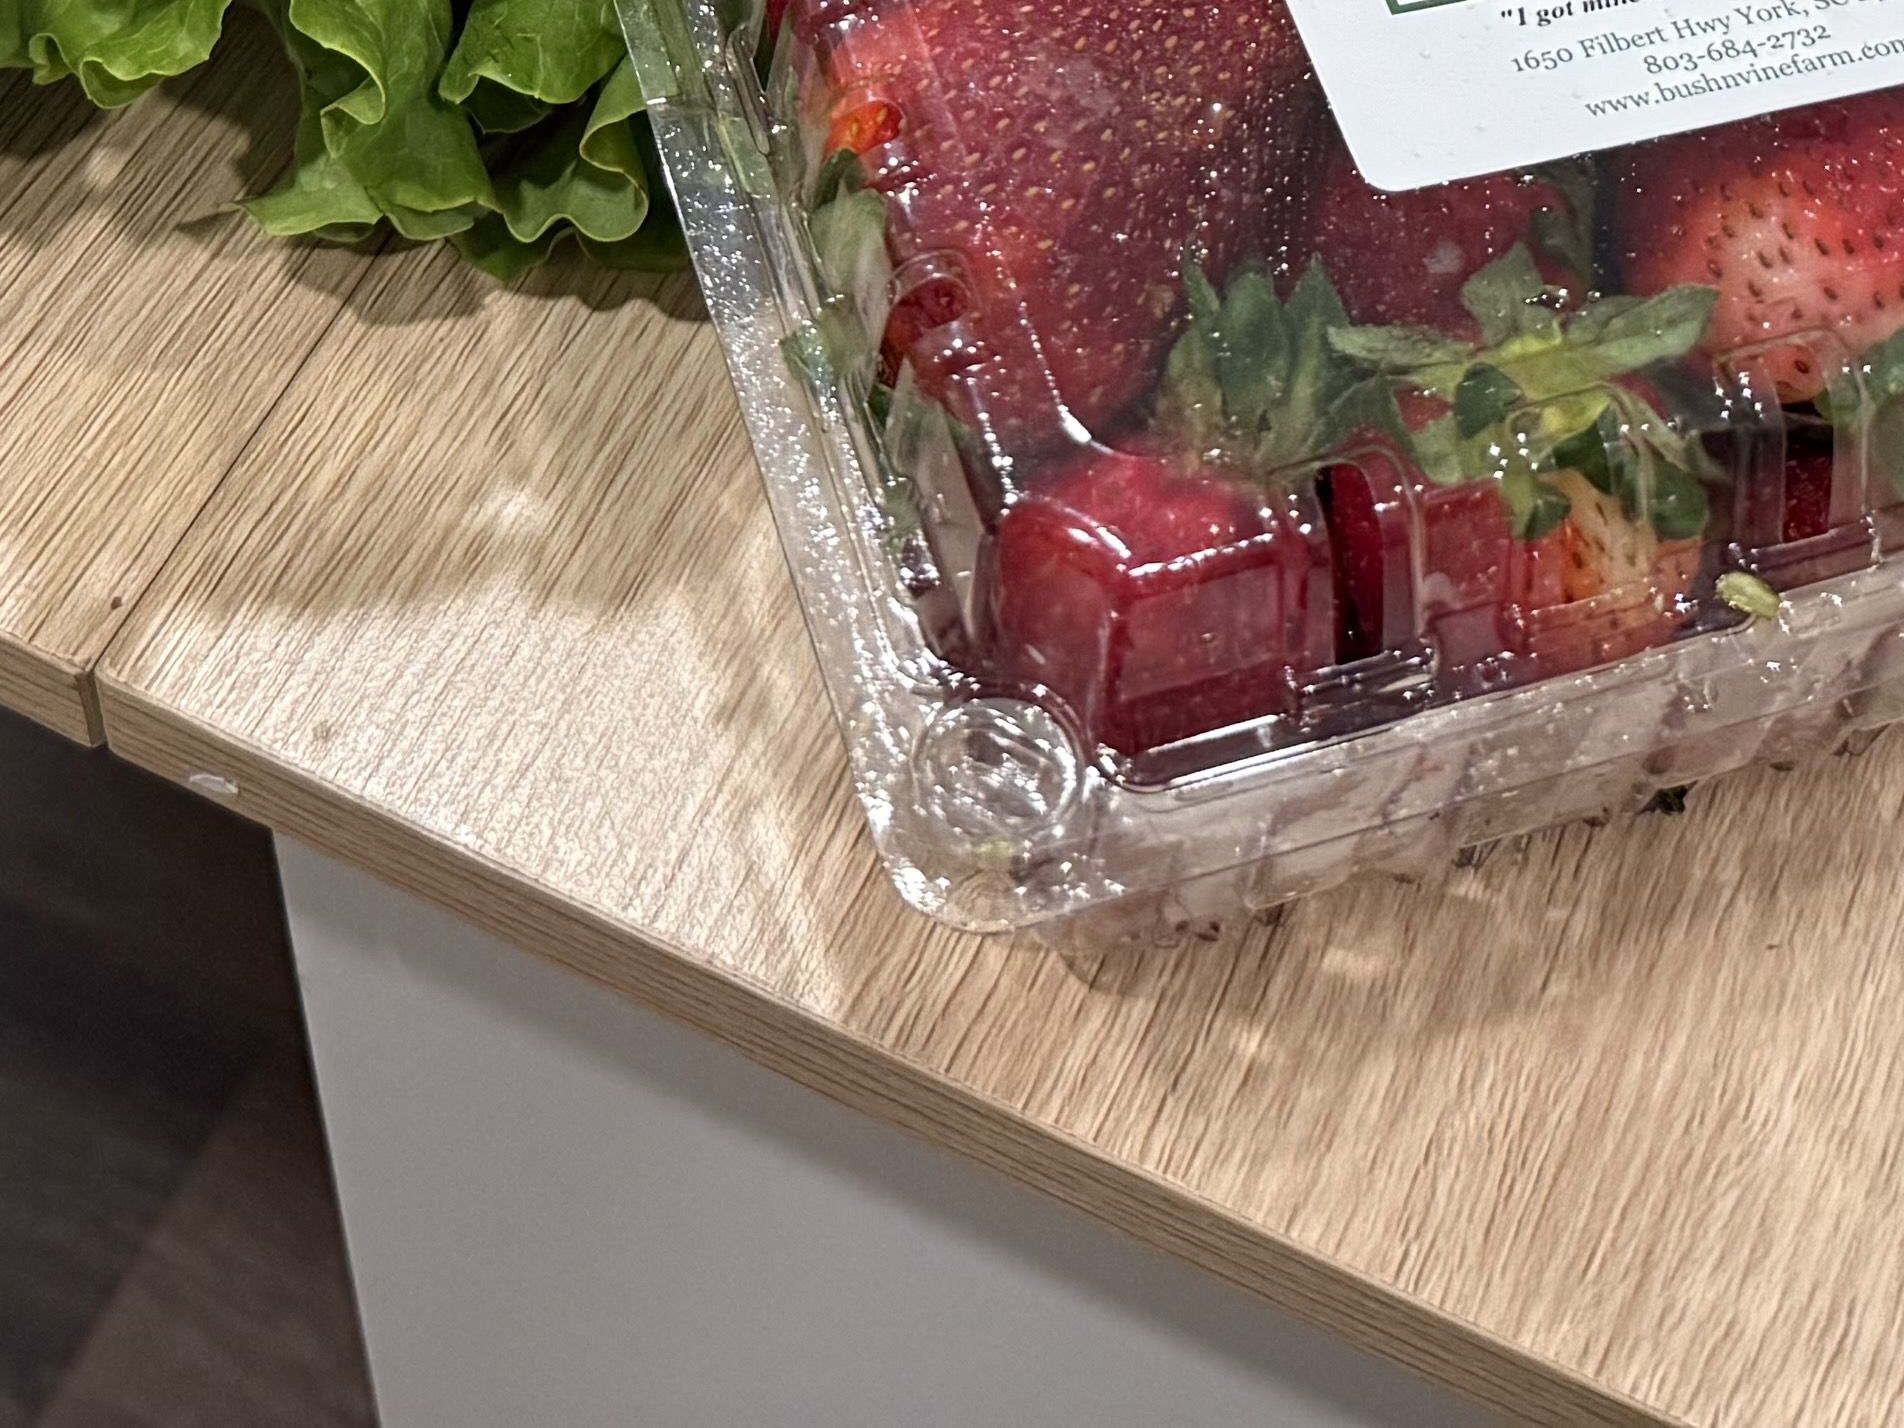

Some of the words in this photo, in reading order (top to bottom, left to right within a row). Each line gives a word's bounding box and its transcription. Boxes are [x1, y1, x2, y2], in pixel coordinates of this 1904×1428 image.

[1501, 7, 1527, 26] "I
[1536, 0, 1574, 27] got
[1511, 47, 1574, 73] 1650
[1577, 25, 1668, 58] Filbert
[1670, 15, 1731, 40] Hwy
[1643, 25, 1831, 75] 803-684-2732
